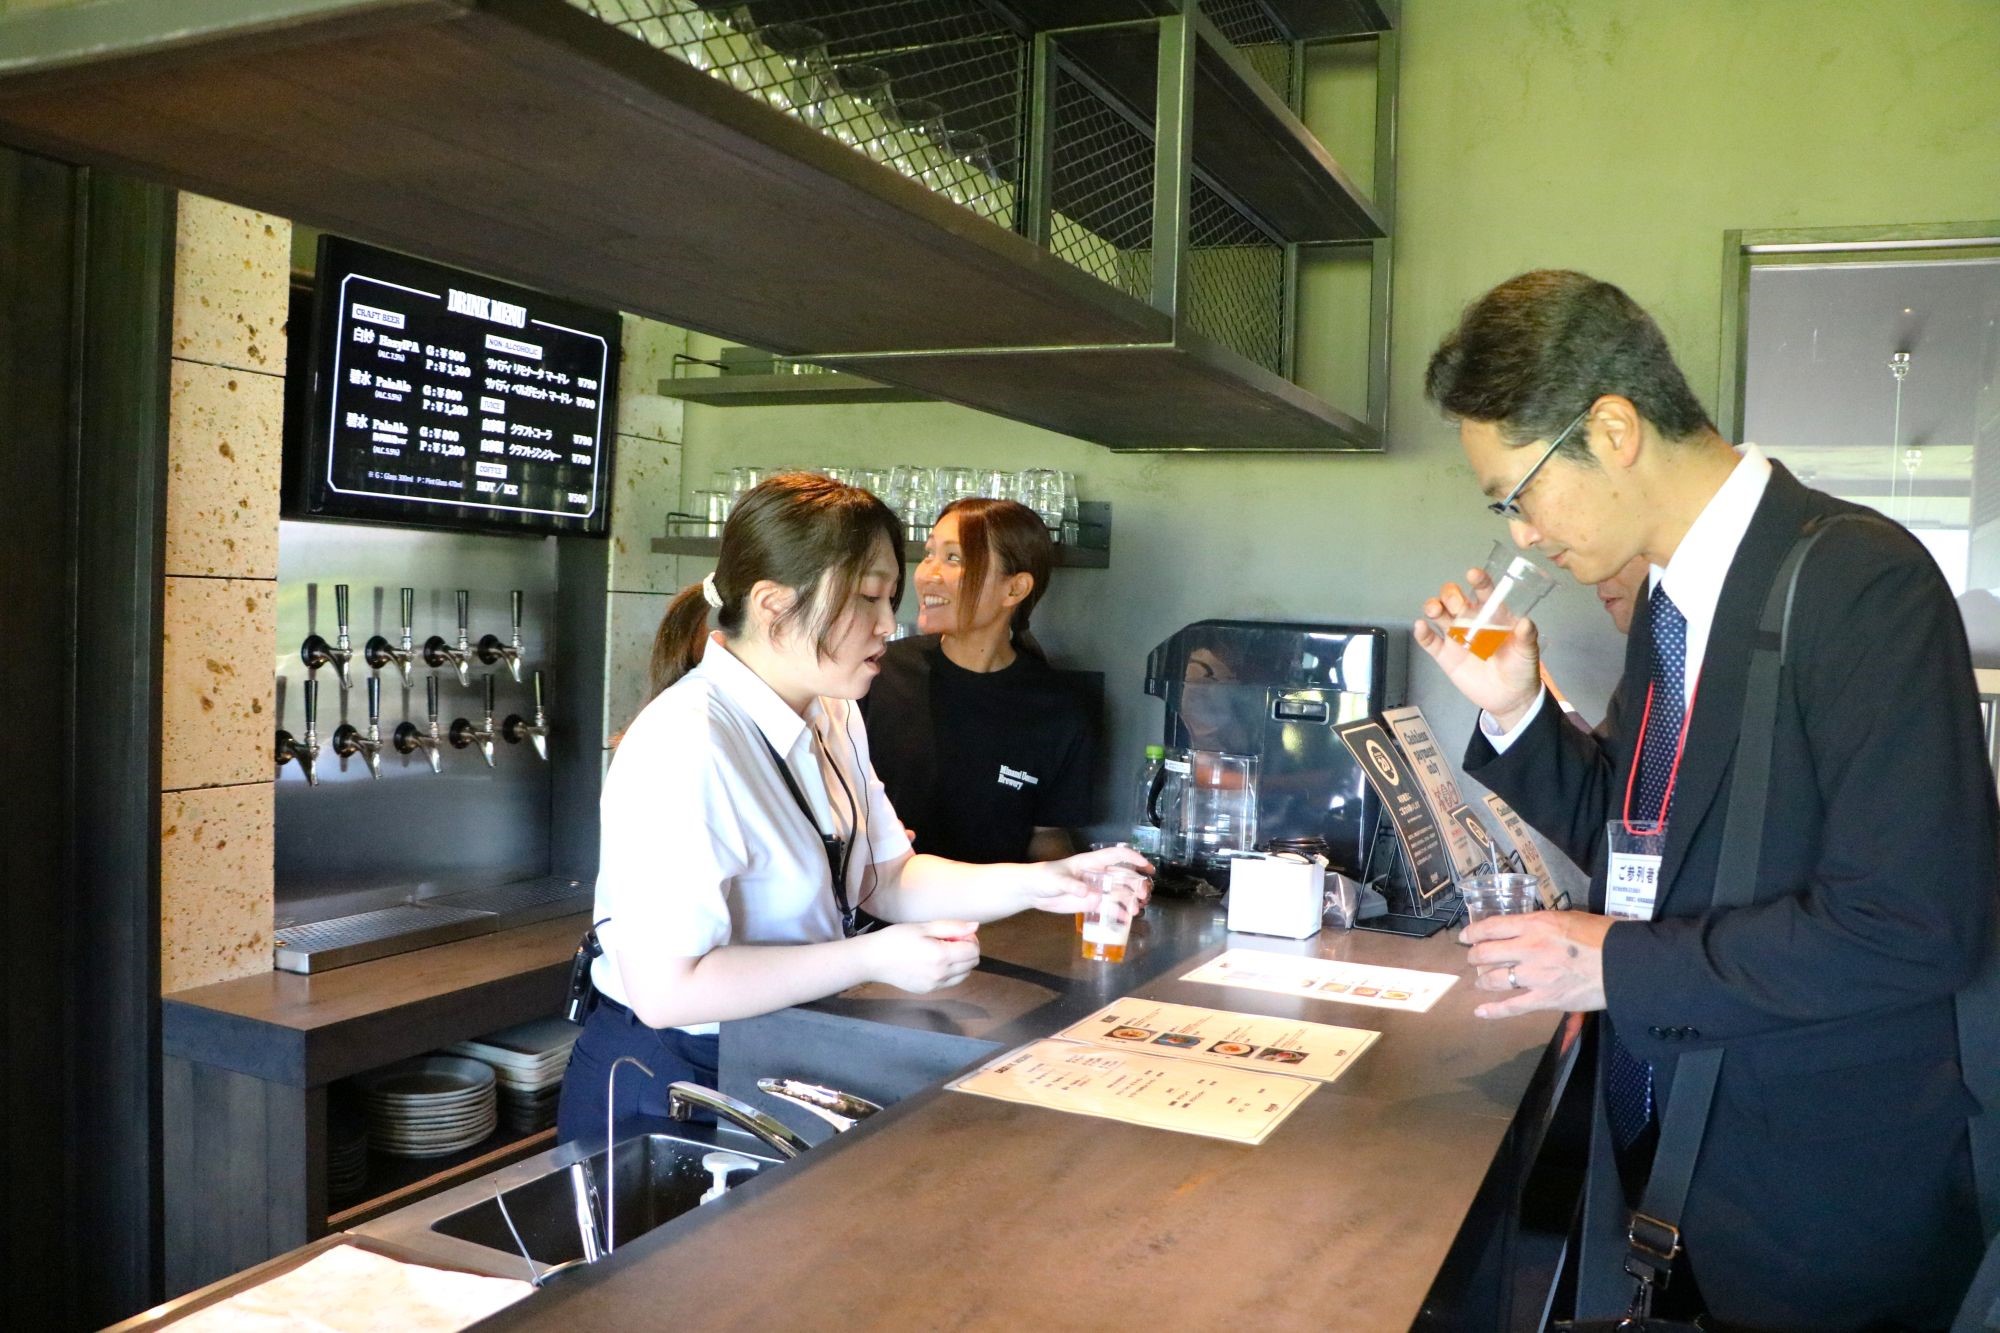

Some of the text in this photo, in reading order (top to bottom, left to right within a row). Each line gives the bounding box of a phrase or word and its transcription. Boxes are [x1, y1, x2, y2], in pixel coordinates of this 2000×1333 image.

[355, 307, 401, 325] CRAFT BEER
[447, 288, 527, 329] DRINK MENU
[483, 400, 501, 410] JUICE
[511, 423, 552, 441] クラフトコーラ
[479, 465, 503, 475] COFFEE
